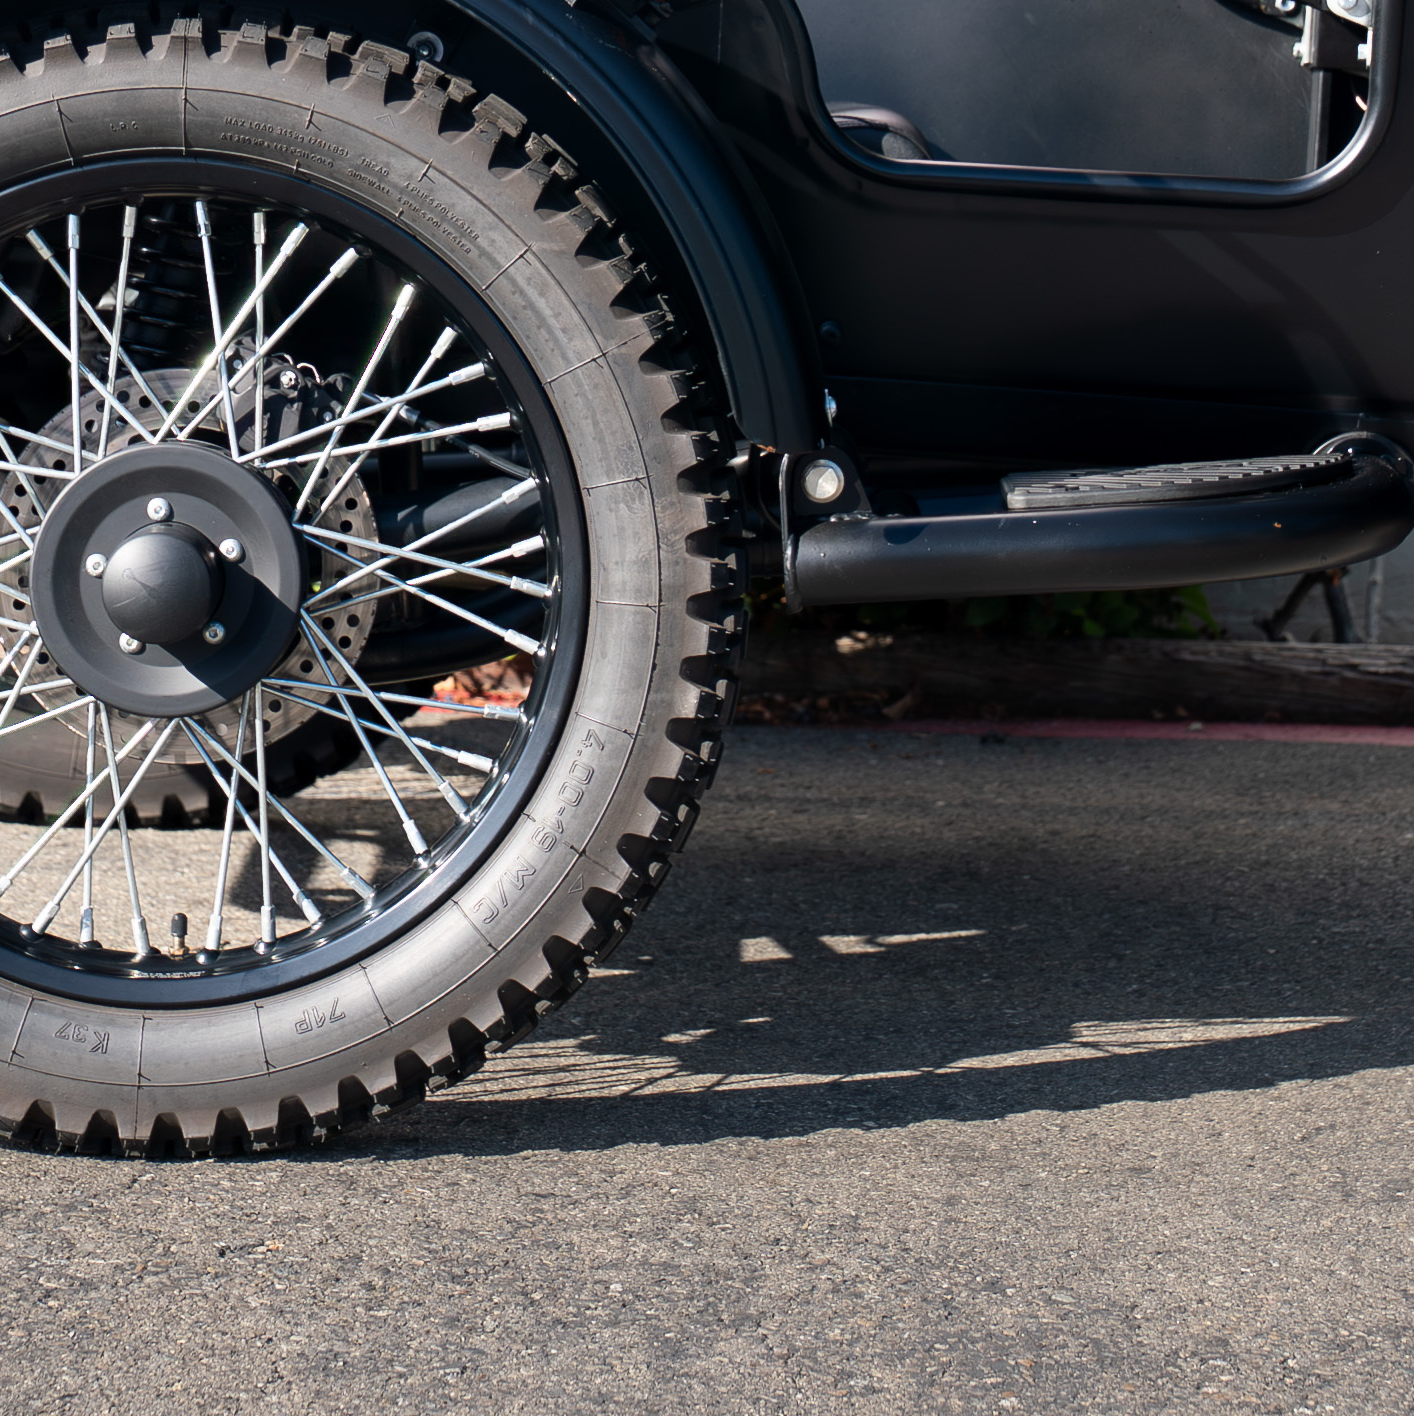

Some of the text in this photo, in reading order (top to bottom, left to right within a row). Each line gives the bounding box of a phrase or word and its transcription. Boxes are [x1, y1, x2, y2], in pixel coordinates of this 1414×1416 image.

[471, 726, 608, 927] 4.00-19 M/C
[293, 996, 347, 1035] 71P
